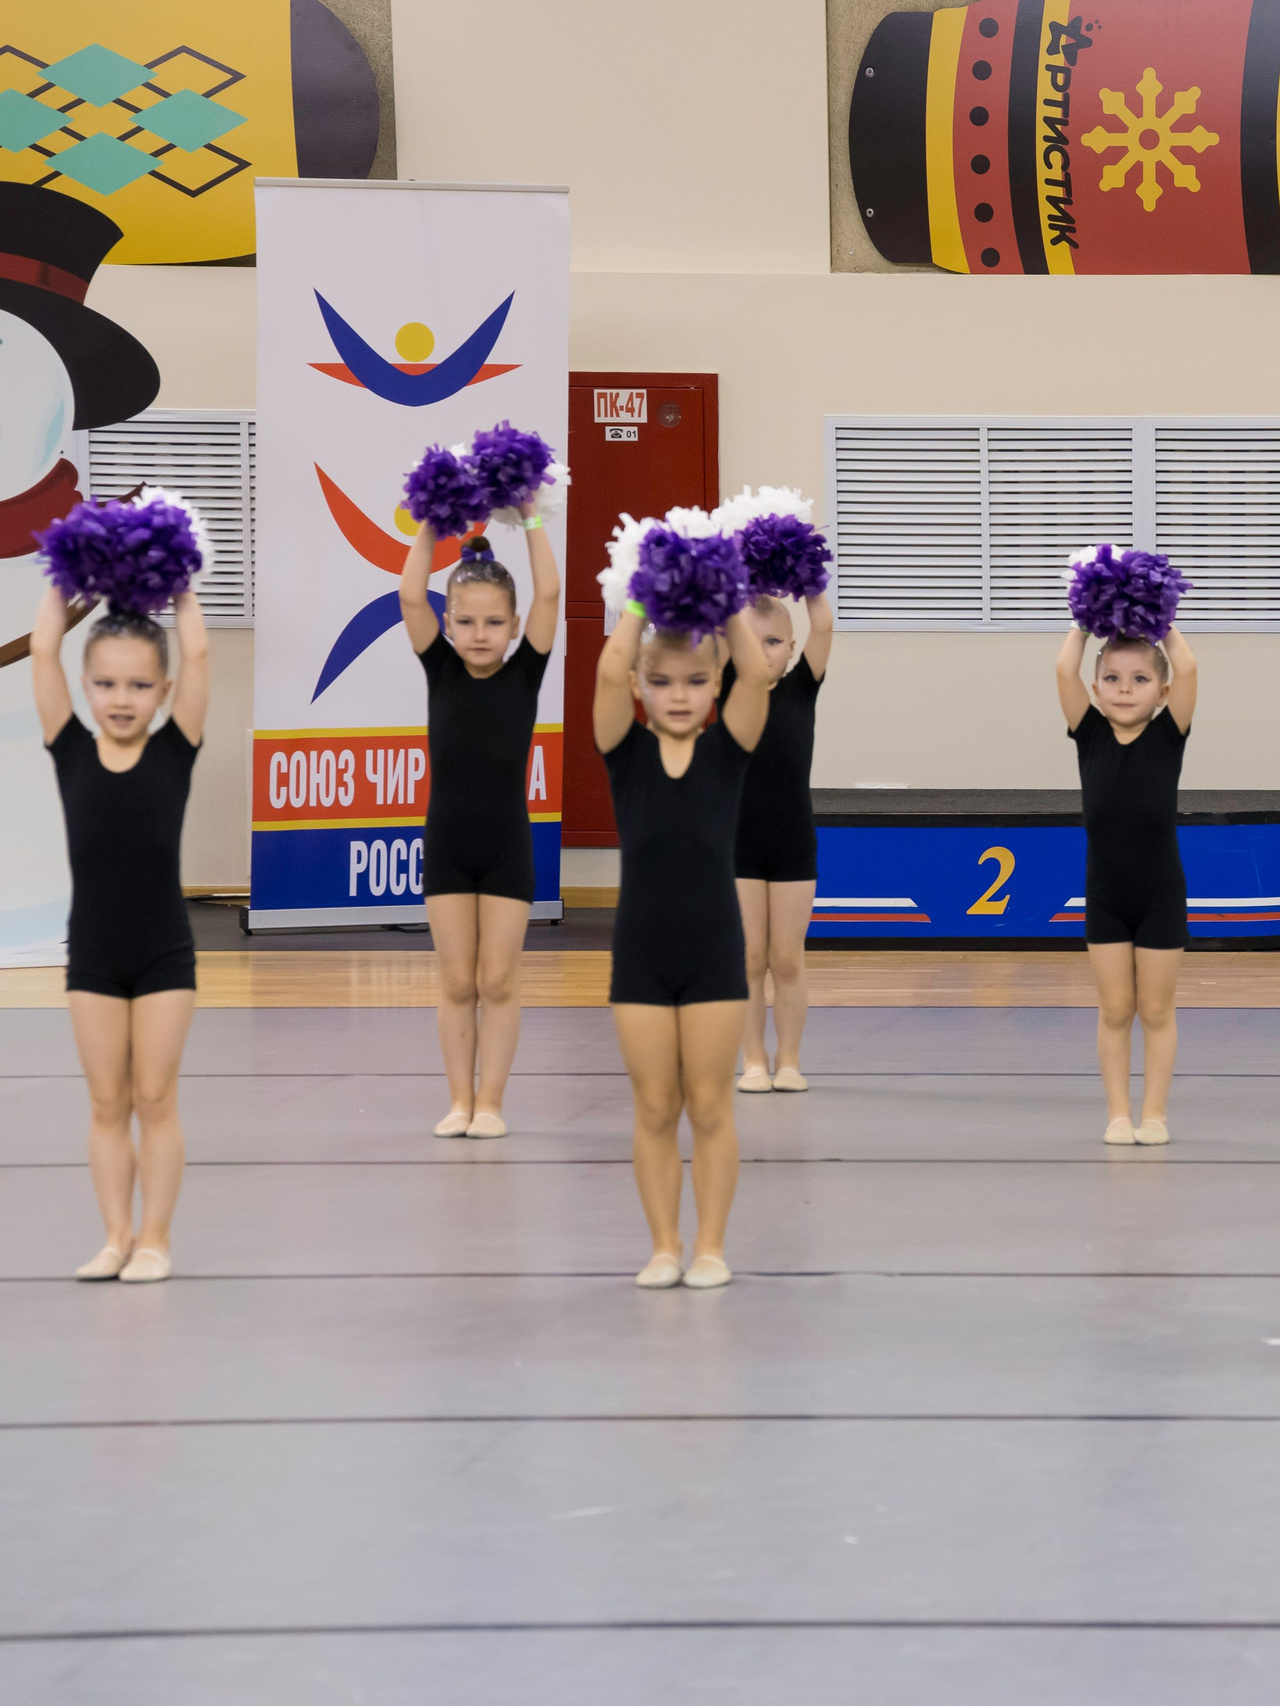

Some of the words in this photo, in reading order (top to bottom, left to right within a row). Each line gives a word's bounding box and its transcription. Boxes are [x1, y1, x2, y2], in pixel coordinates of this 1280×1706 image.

[596, 392, 645, 418] ПК-47
[626, 430, 637, 439] 01
[269, 749, 356, 809] СОЮЗ
[349, 838, 424, 897] РОСС
[966, 846, 1016, 915] 2
